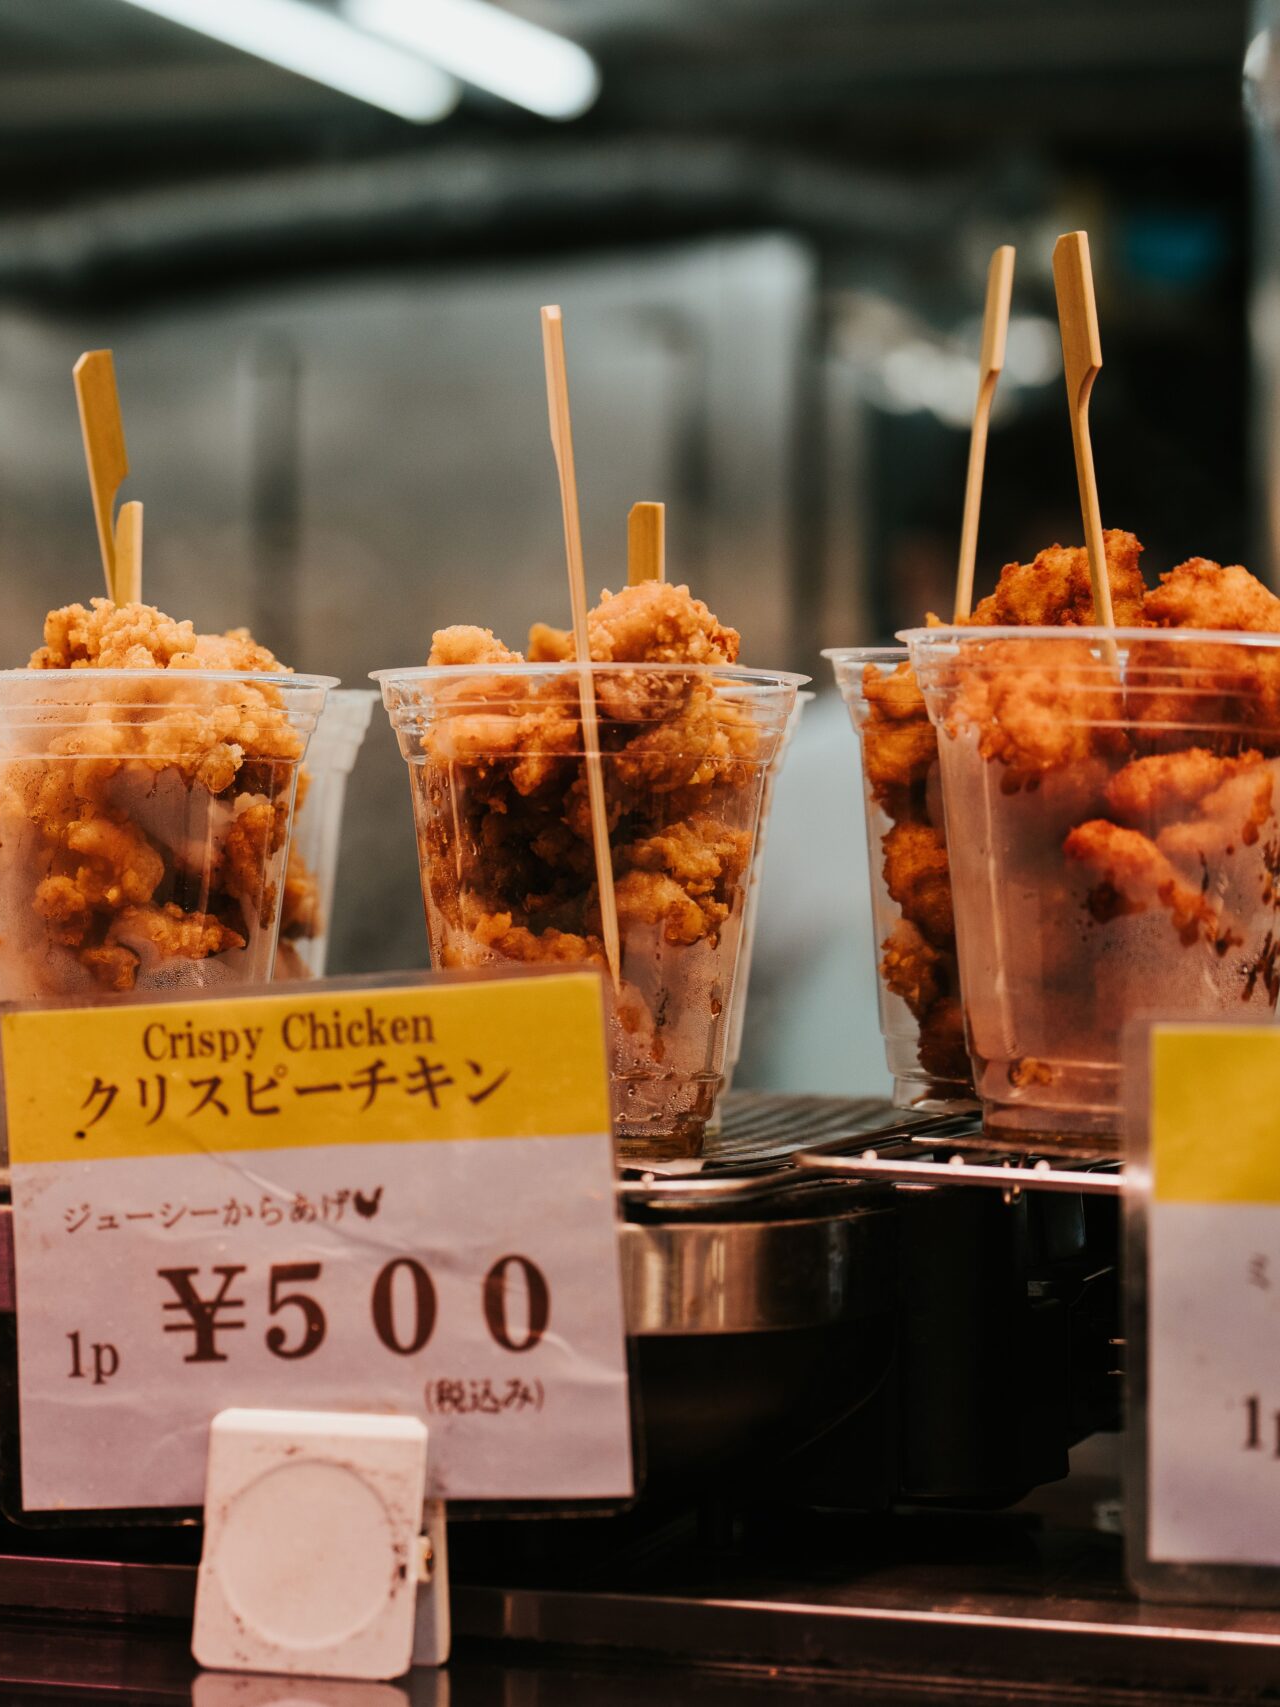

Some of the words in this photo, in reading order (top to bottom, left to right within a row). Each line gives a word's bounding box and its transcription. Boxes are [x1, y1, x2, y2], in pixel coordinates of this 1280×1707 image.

[142, 1019, 264, 1062] Crispy
[281, 1007, 436, 1052] Chicken
[81, 1055, 513, 1127] クリスピーチキン
[67, 1330, 120, 1386] 1p
[157, 1255, 551, 1364] ¥500
[424, 1377, 545, 1415] (税込み)
[1244, 1395, 1280, 1460] 1
